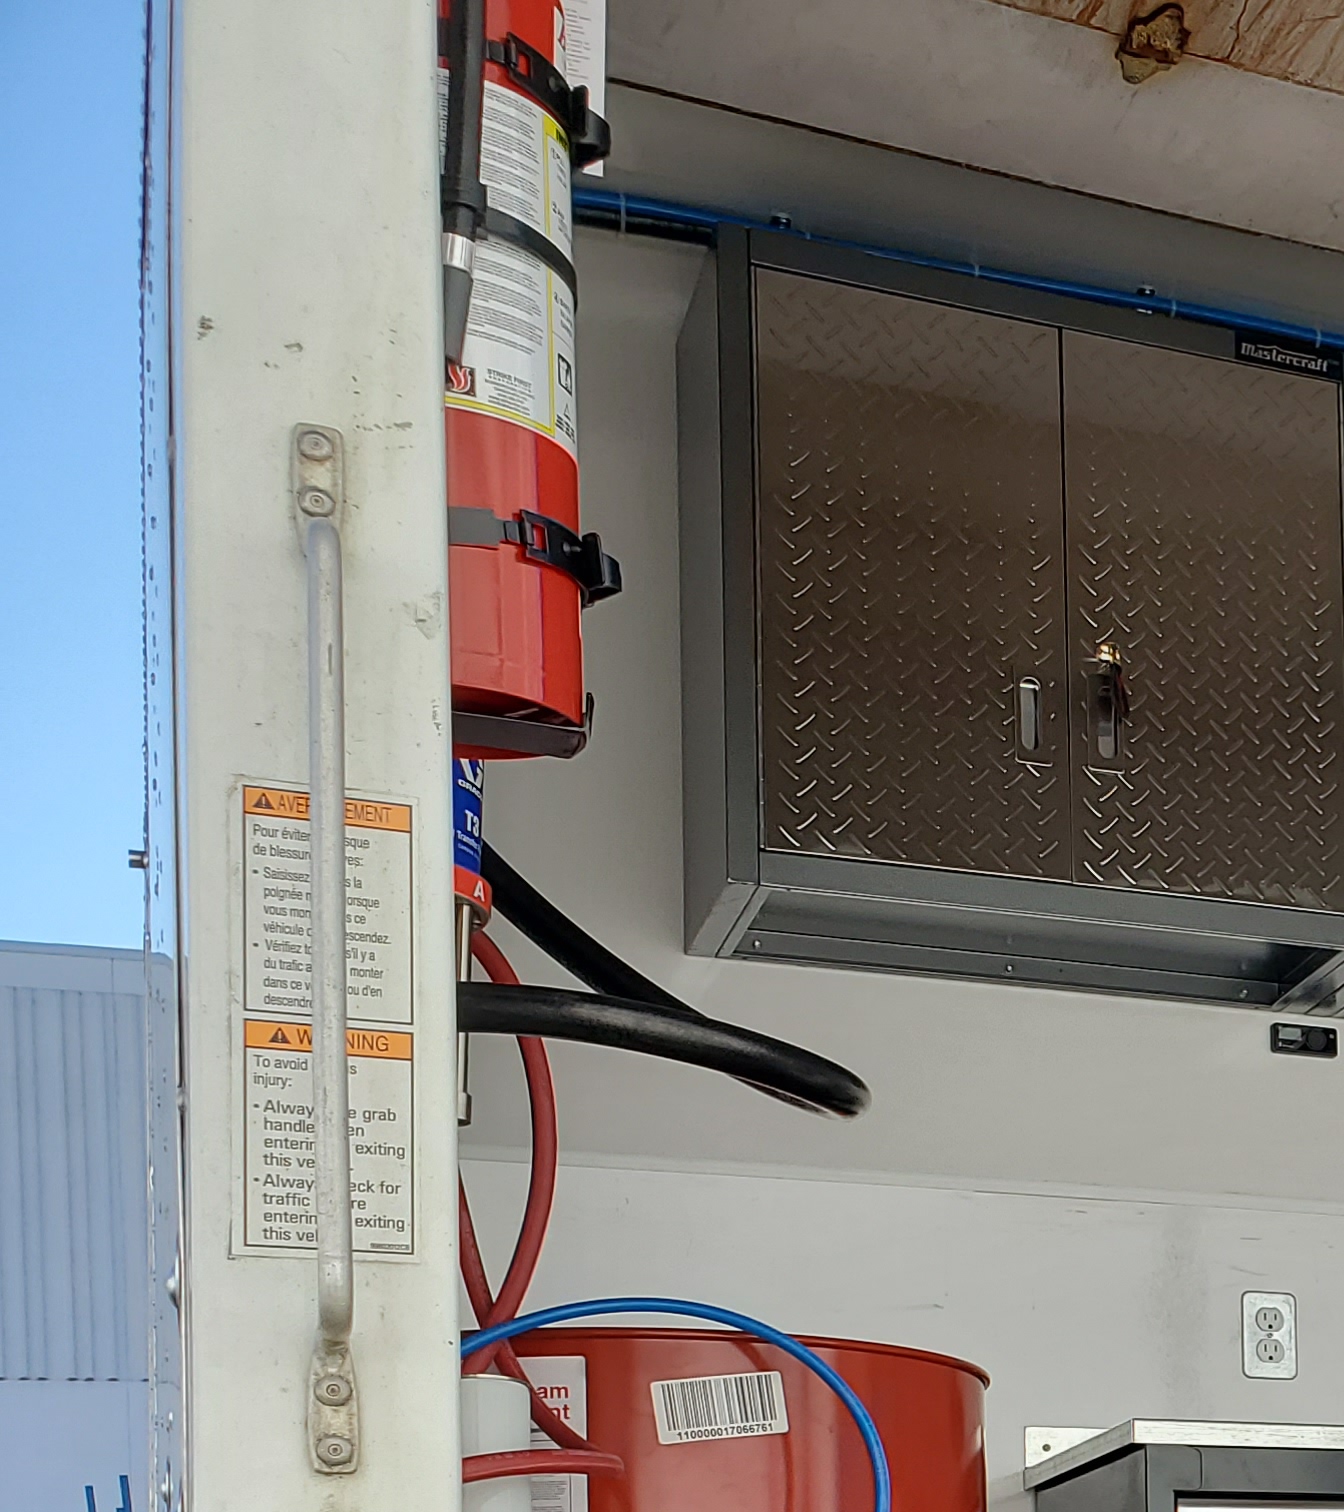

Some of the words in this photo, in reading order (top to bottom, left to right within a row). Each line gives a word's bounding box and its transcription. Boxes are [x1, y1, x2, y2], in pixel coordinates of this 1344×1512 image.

[276, 796, 392, 823] AVEEMENT
[253, 824, 279, 839] Pour
[344, 838, 370, 850] sque
[253, 843, 266, 856] de
[270, 845, 312, 861] blessur
[263, 866, 310, 882] Saisissez
[353, 878, 362, 889] la
[263, 884, 303, 902] poignée
[347, 896, 380, 912] orsque
[473, 880, 485, 902] A
[263, 905, 287, 916] vous
[354, 915, 366, 924] ce
[263, 921, 304, 936] véhicule
[345, 932, 391, 945] escendez.
[265, 938, 302, 954] Vérifiez
[369, 952, 375, 961] a
[263, 957, 277, 969] du
[279, 959, 304, 971] trafic
[350, 966, 383, 979] monter
[263, 976, 288, 989] dans
[290, 980, 302, 990] ce
[347, 985, 360, 995] ou
[362, 985, 382, 997] d'en
[297, 1028, 389, 1051] WNING
[253, 1055, 270, 1068] To
[273, 1057, 308, 1071] avoid
[253, 1073, 292, 1089] injury:
[263, 1100, 314, 1118] Alway
[362, 1108, 396, 1122] grab
[263, 1118, 315, 1133] handle
[348, 1126, 365, 1137] en
[263, 1153, 291, 1166] this
[355, 1143, 406, 1160] exiting
[263, 1174, 315, 1192] Alway
[349, 1180, 375, 1193] eck
[380, 1181, 401, 1195] for
[263, 1192, 310, 1207] traffic
[263, 1211, 317, 1225] enterin
[355, 1215, 405, 1232] exiting
[263, 1227, 291, 1240] this
